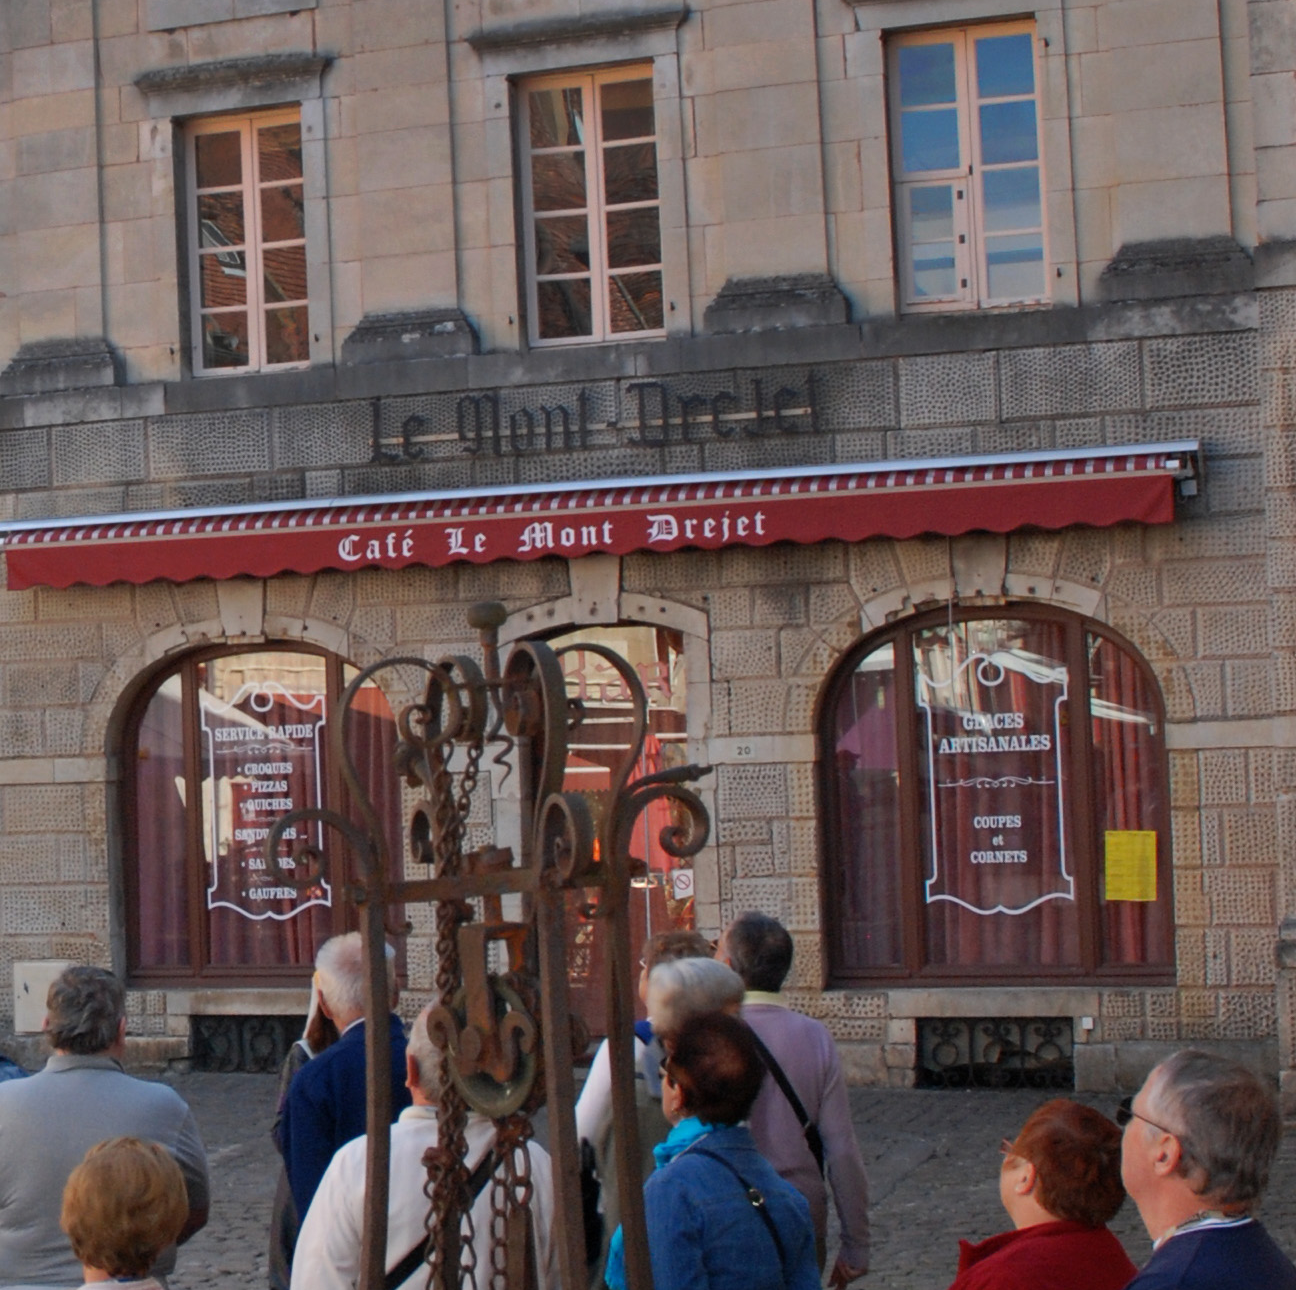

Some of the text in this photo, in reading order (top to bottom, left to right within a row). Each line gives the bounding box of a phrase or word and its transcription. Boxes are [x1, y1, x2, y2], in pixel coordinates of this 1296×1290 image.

[369, 395, 432, 463] Le
[338, 510, 766, 561] Café Le Mont Drejet
[962, 712, 1024, 730] GLACES
[215, 724, 313, 742] SERVICE RAPIDE
[736, 746, 751, 756] 20
[938, 735, 1051, 754] ARTISANALES
[244, 762, 293, 775] CROQUES
[251, 780, 288, 792] PIZZAS
[246, 798, 293, 811] QUICHES
[973, 815, 1022, 828] COUPES
[992, 834, 1004, 846] et
[970, 850, 1028, 864] CORNETS
[248, 887, 297, 900] GAUFRES
